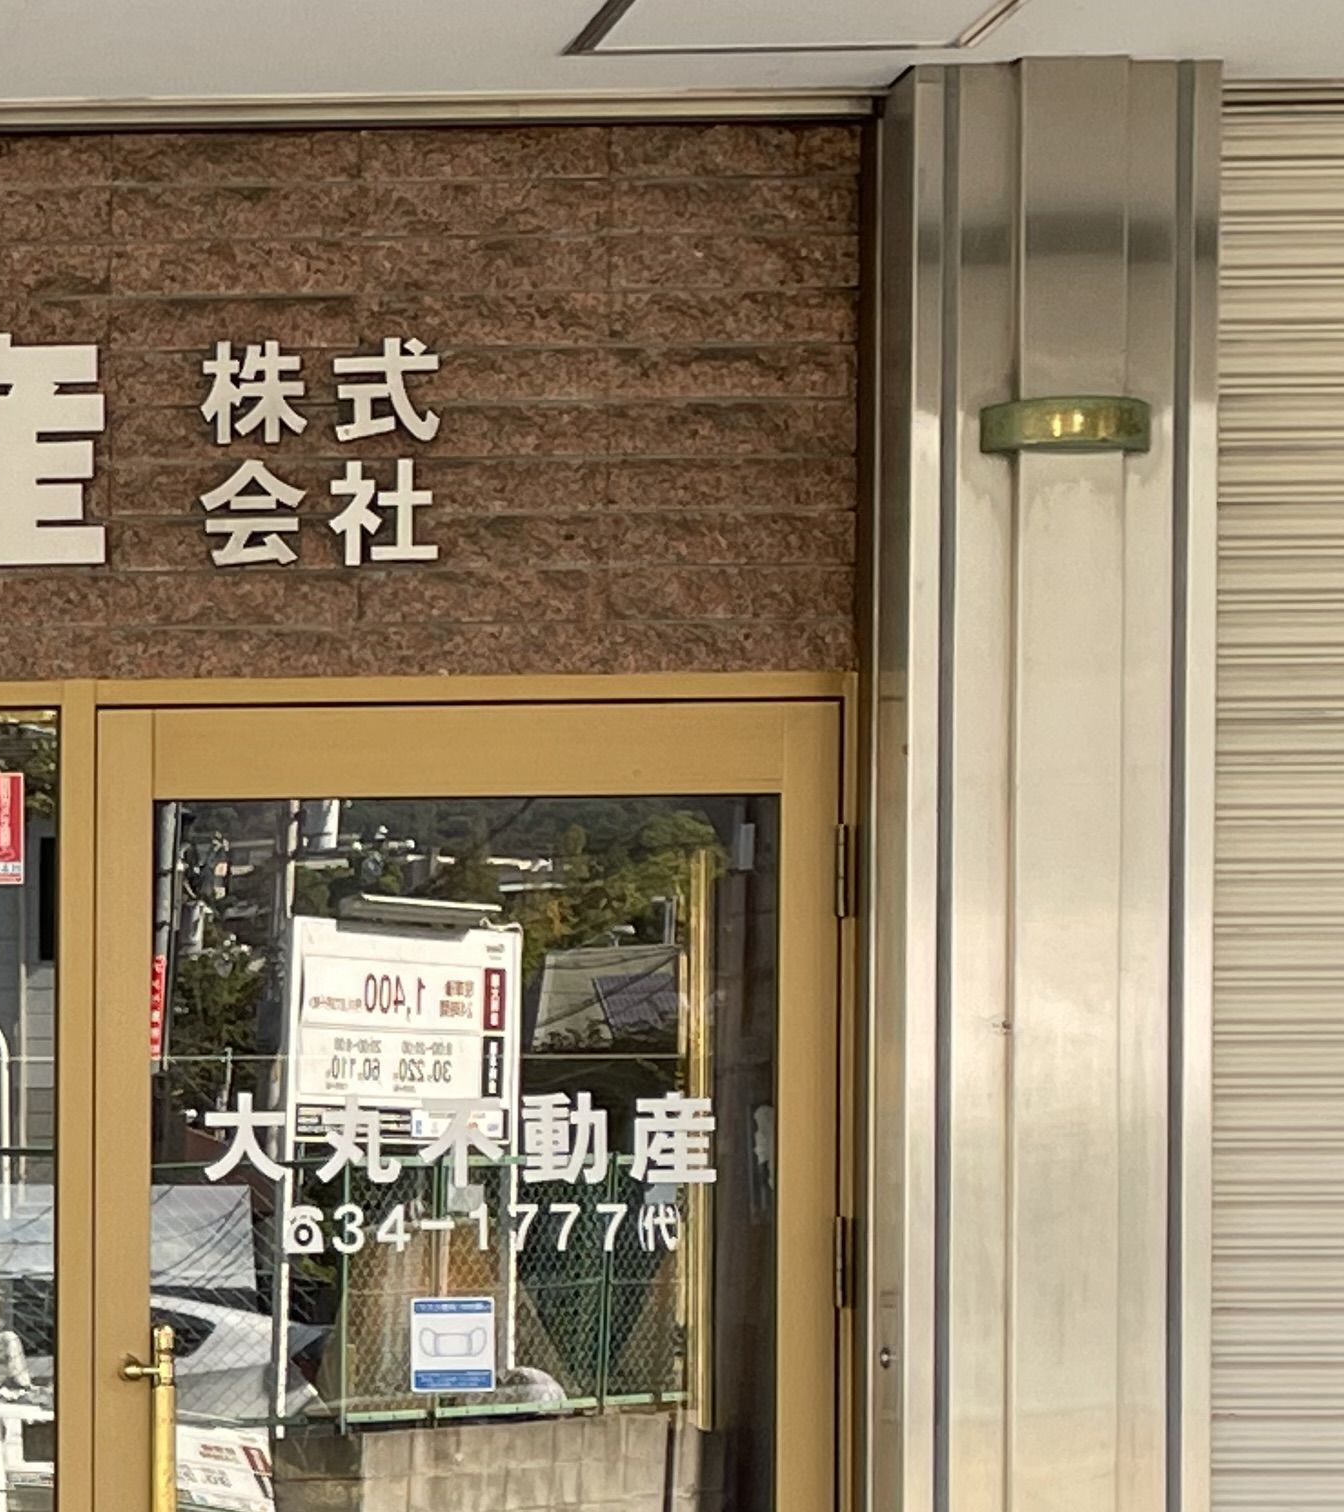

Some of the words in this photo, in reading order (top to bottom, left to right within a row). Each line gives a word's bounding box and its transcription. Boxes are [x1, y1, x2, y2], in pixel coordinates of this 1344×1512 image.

[201, 338, 439, 446] 株式
[201, 459, 439, 570] 会社
[205, 1091, 716, 1187] 大丸不動産
